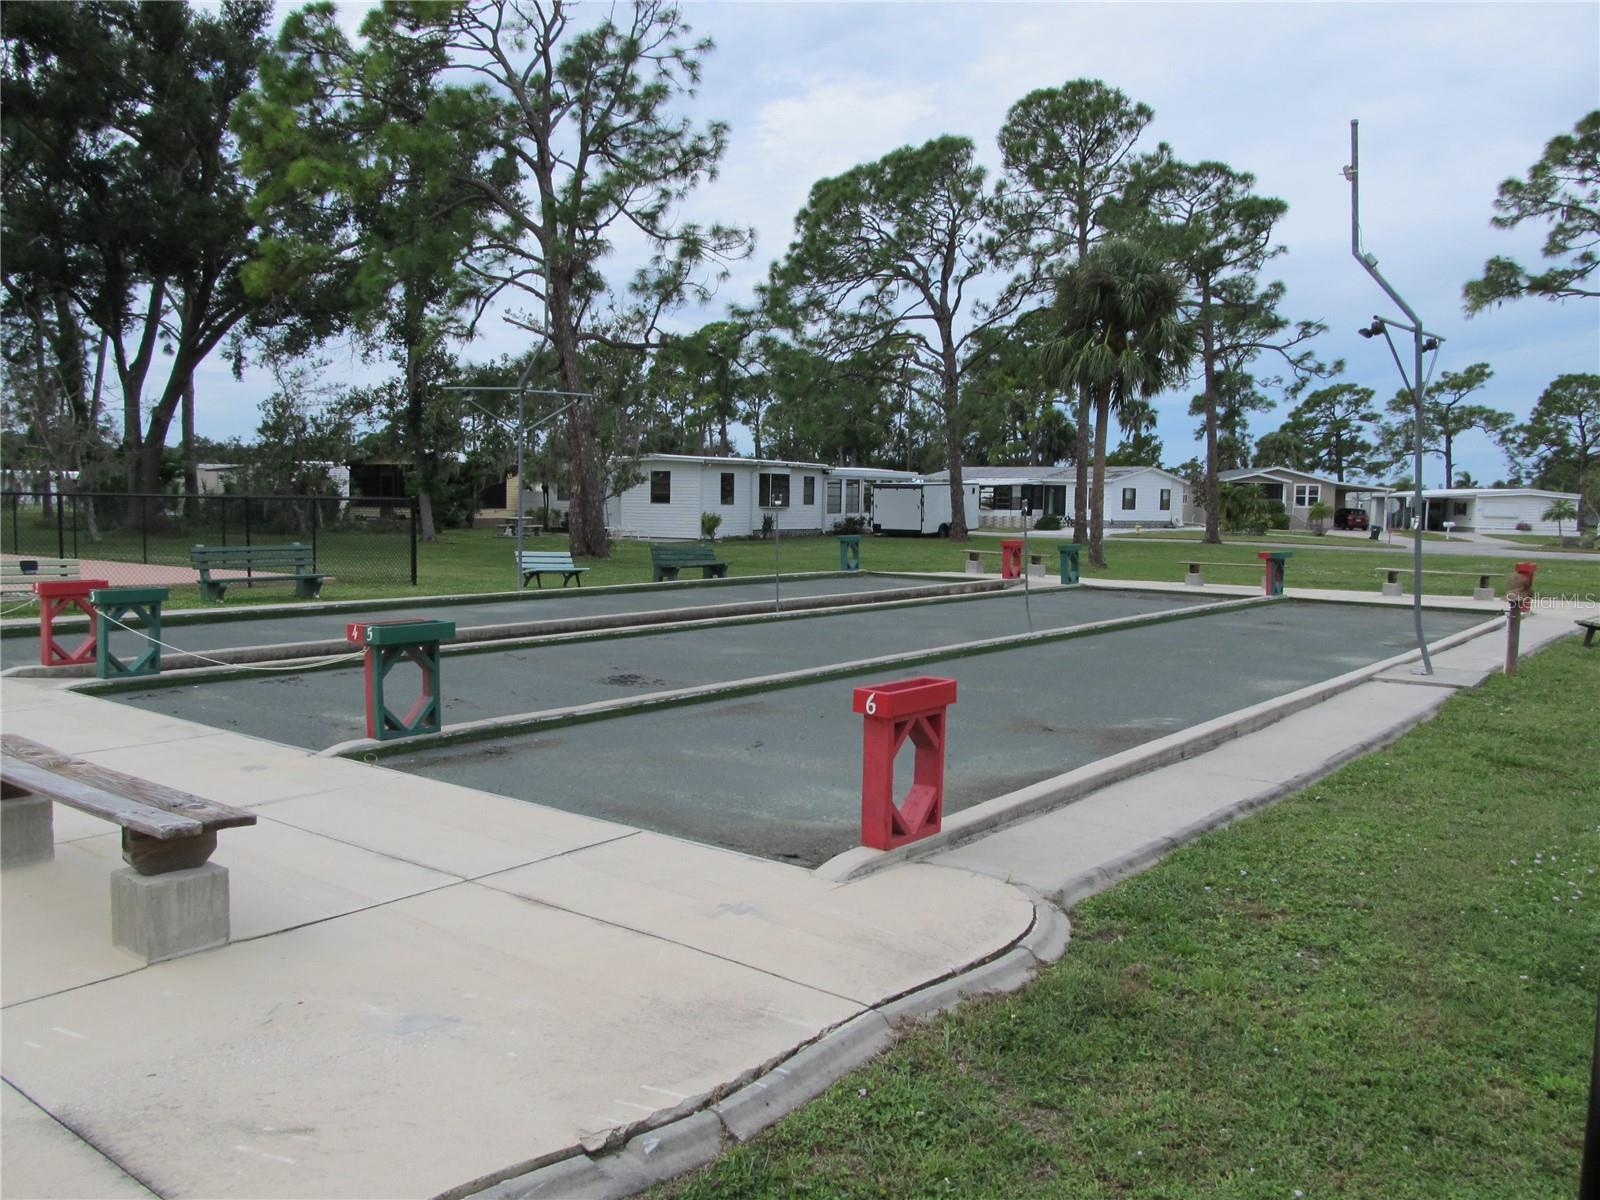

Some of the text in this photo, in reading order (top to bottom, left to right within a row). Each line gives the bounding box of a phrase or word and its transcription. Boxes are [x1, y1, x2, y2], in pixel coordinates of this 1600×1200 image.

[351, 625, 358, 640] 4
[366, 626, 373, 641] 5
[865, 692, 876, 715] 6
